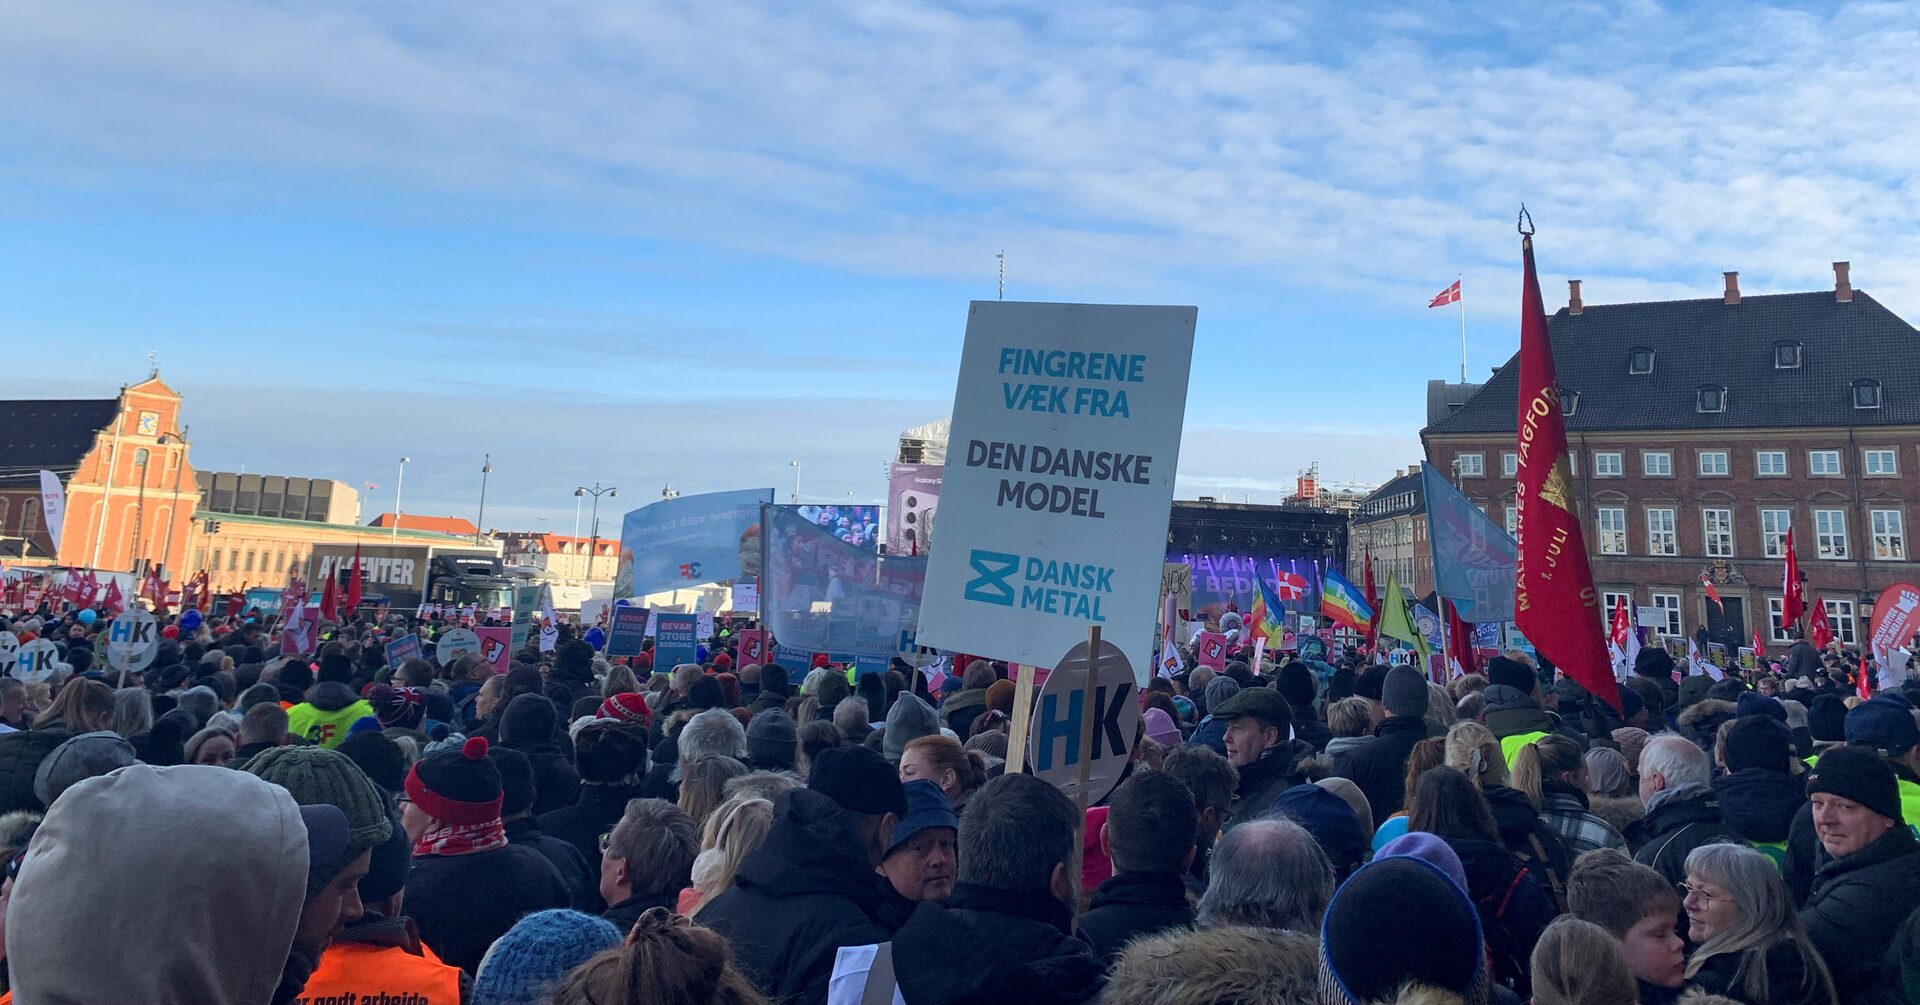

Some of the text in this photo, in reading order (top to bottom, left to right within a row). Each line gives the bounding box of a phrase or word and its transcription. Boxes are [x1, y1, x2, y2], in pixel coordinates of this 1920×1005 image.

[998, 347, 1147, 382] FINGRENE
[1003, 382, 1130, 418] VÆK FRA
[966, 439, 1152, 485] DEN DANSKE
[996, 479, 1105, 519] MODEL
[1549, 526, 1569, 569] JULI
[1024, 557, 1115, 593] DANSK
[1020, 585, 1106, 622] METAL
[111, 620, 153, 644] HK
[659, 632, 693, 641] STORE
[661, 622, 692, 630] BEVAR
[18, 649, 55, 672] HK
[1392, 653, 1409, 664] HK
[308, 724, 336, 746] 3F
[1037, 682, 1133, 772] HK
